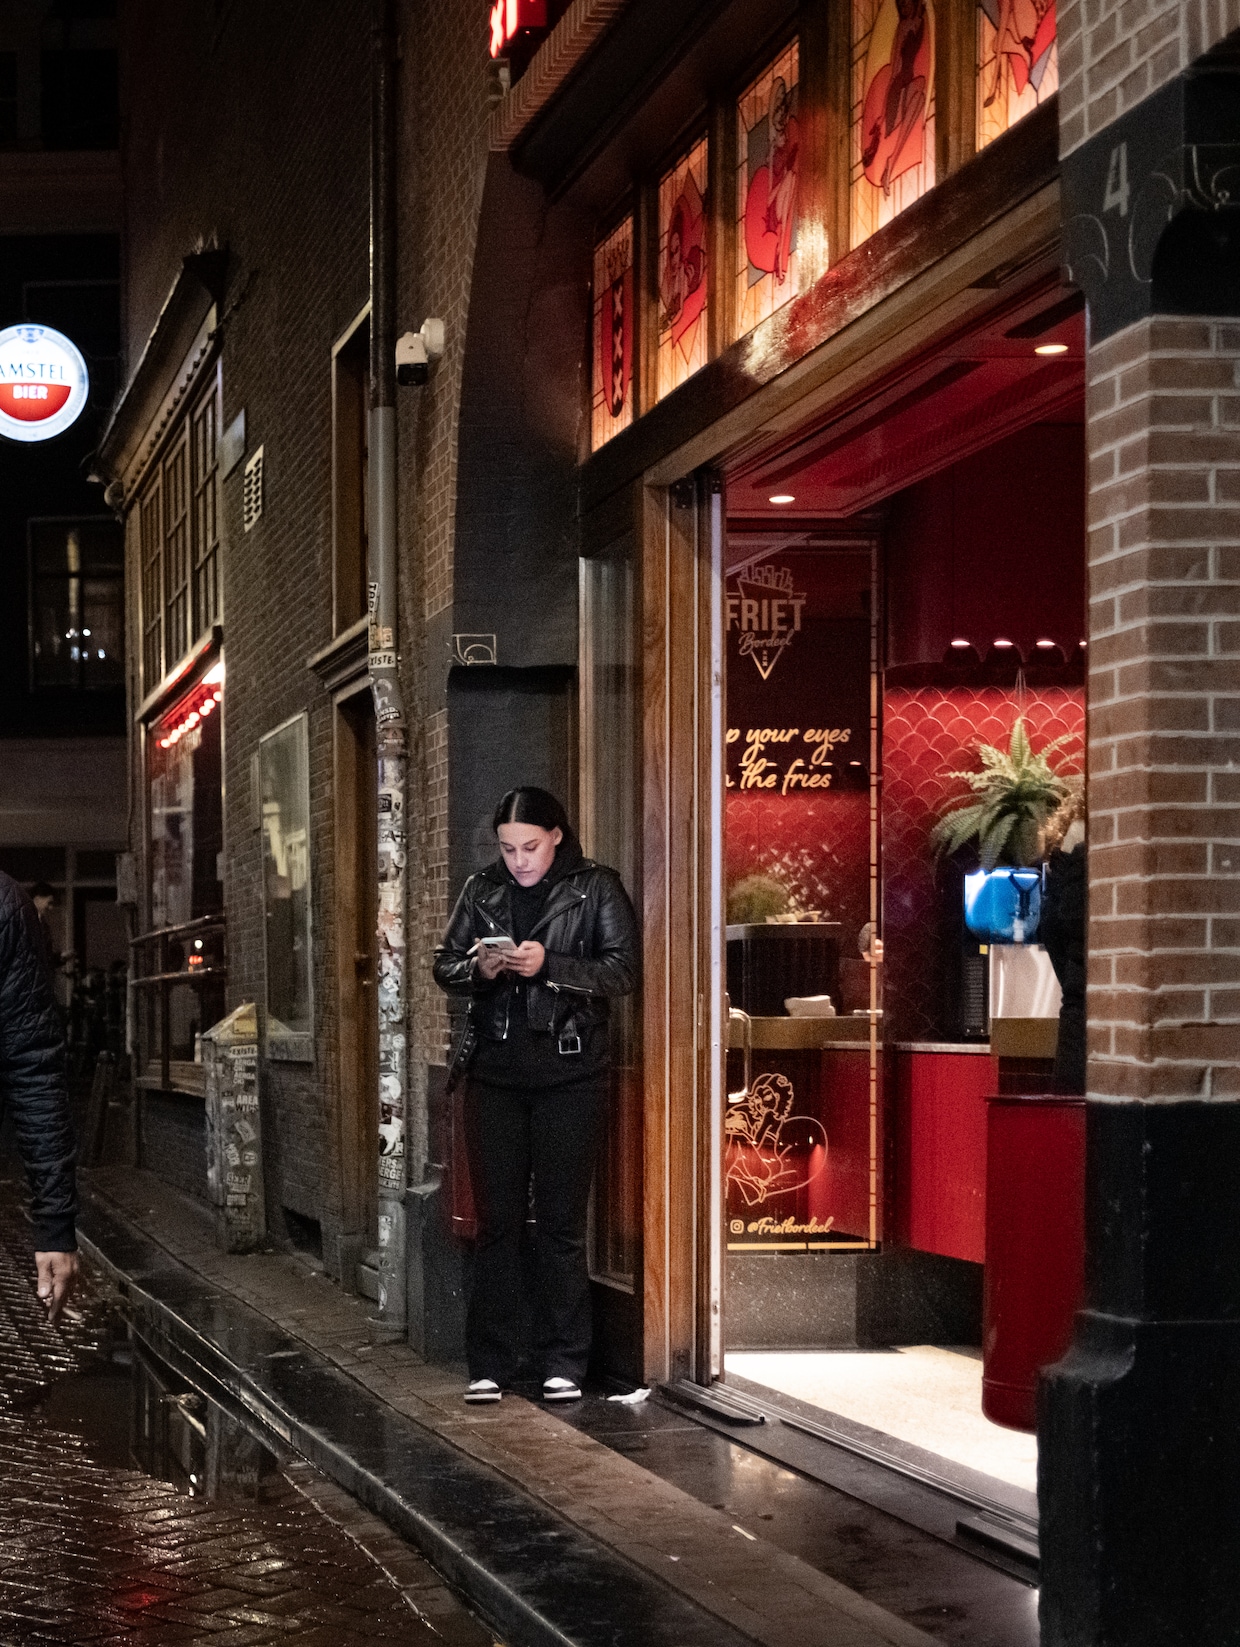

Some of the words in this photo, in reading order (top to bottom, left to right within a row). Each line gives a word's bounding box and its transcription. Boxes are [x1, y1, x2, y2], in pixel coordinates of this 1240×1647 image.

[12, 384, 49, 400] BIER
[725, 598, 807, 632] FRIET
[745, 728, 800, 766] your
[802, 728, 852, 766] eyes
[739, 758, 778, 790] the
[781, 758, 833, 796] fries
